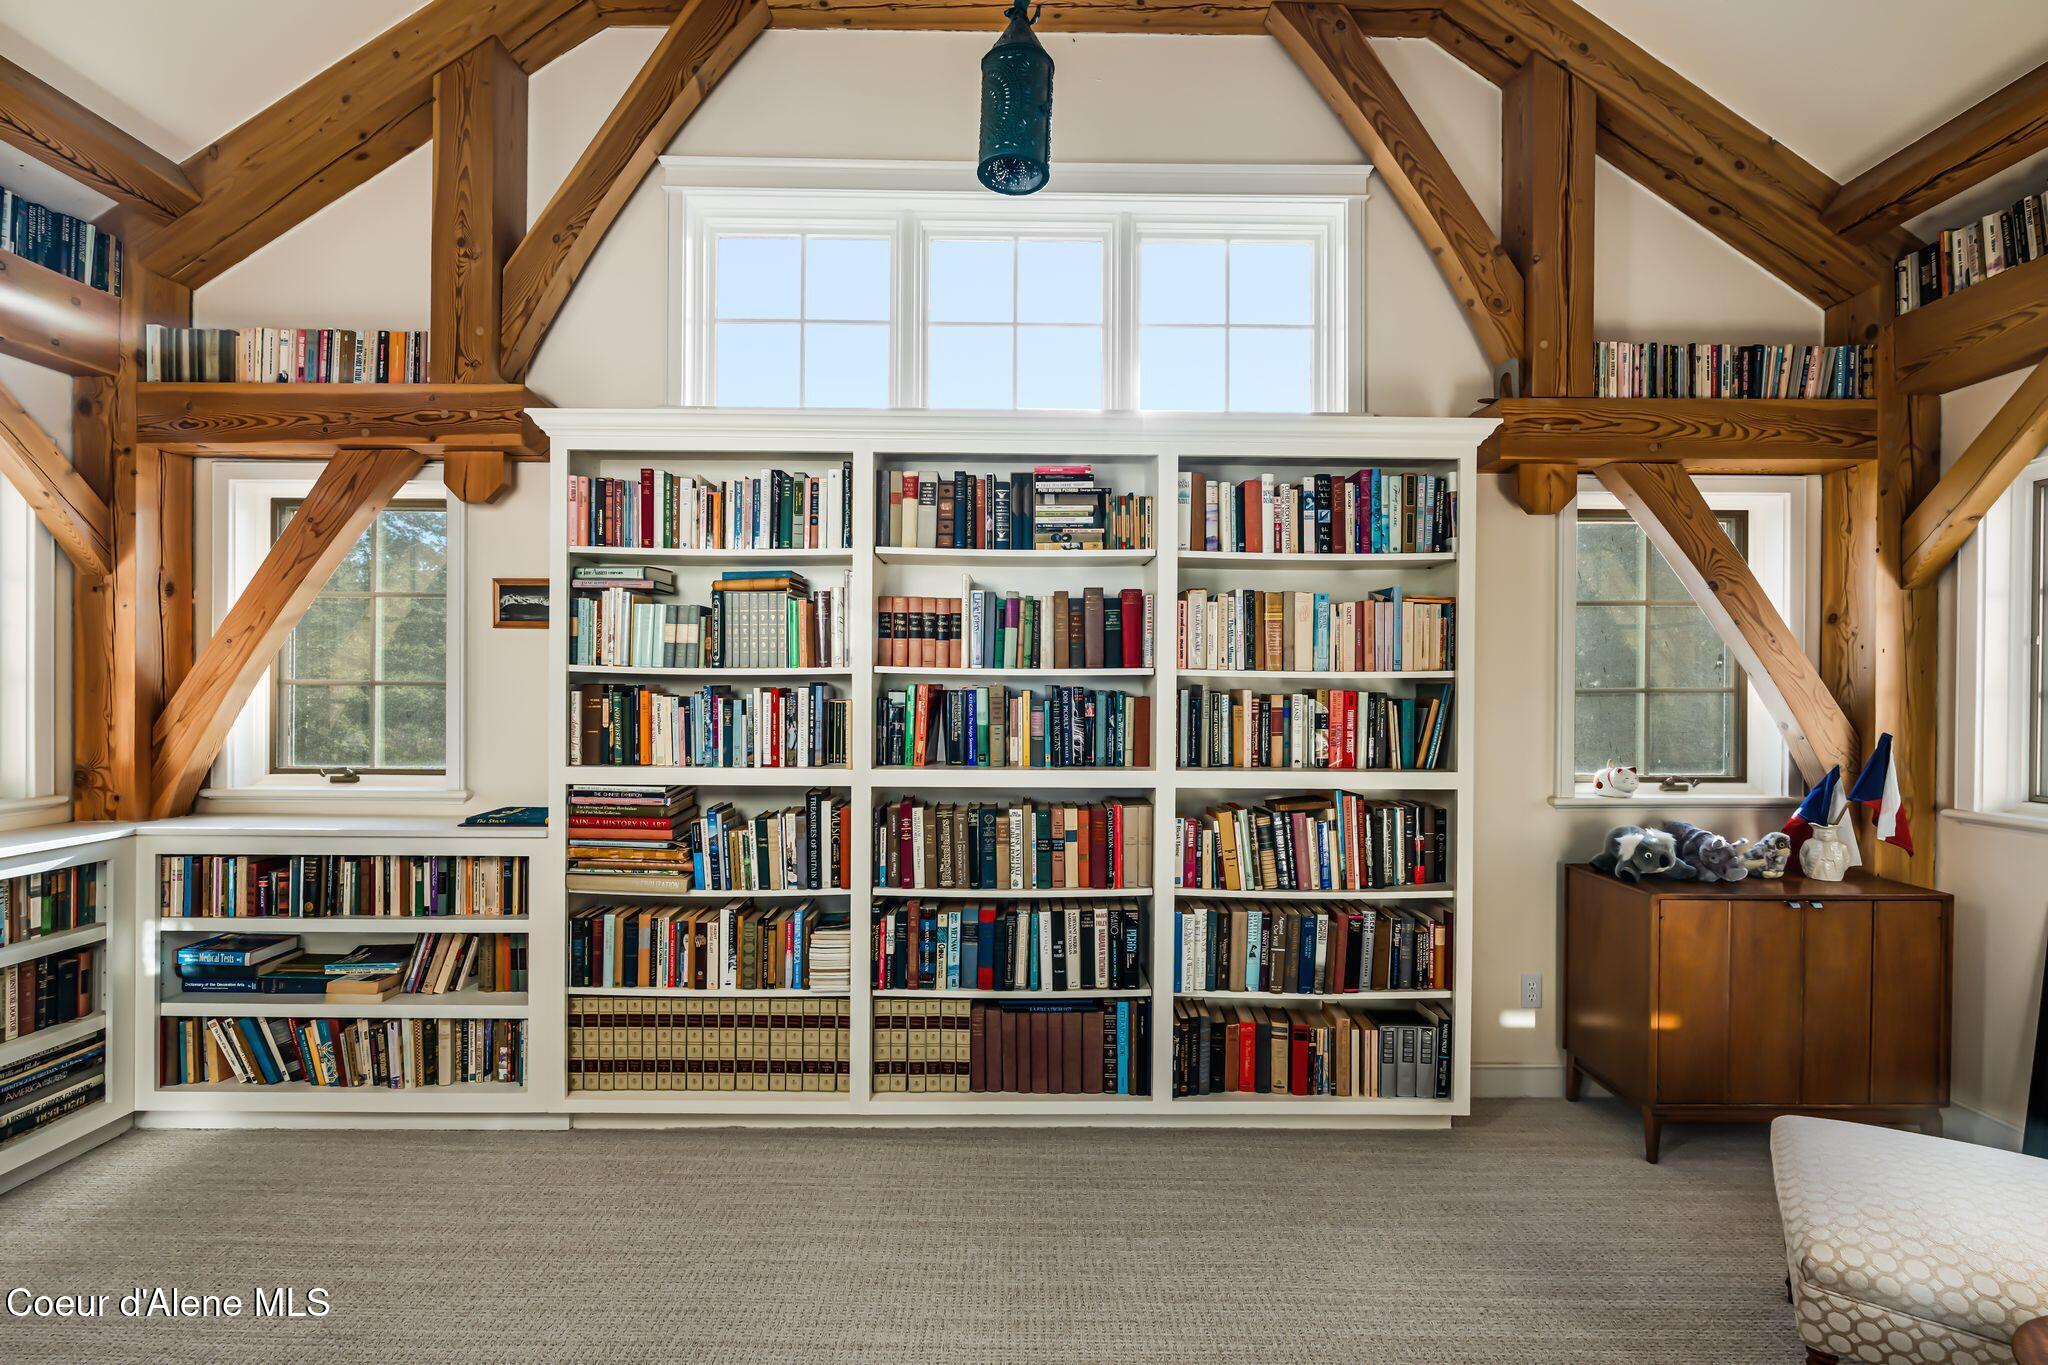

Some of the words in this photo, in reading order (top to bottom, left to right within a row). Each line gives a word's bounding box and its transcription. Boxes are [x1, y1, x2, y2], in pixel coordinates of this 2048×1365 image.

[810, 796, 818, 838] TREASURES
[831, 809, 840, 844] MUSIC
[810, 839, 818, 849] OF
[810, 850, 818, 878] BRITAIN
[1126, 929, 1136, 952] PEGGY
[199, 953, 219, 963] Medical
[220, 953, 234, 963] Tests
[4, 1082, 42, 1103] AMERICA
